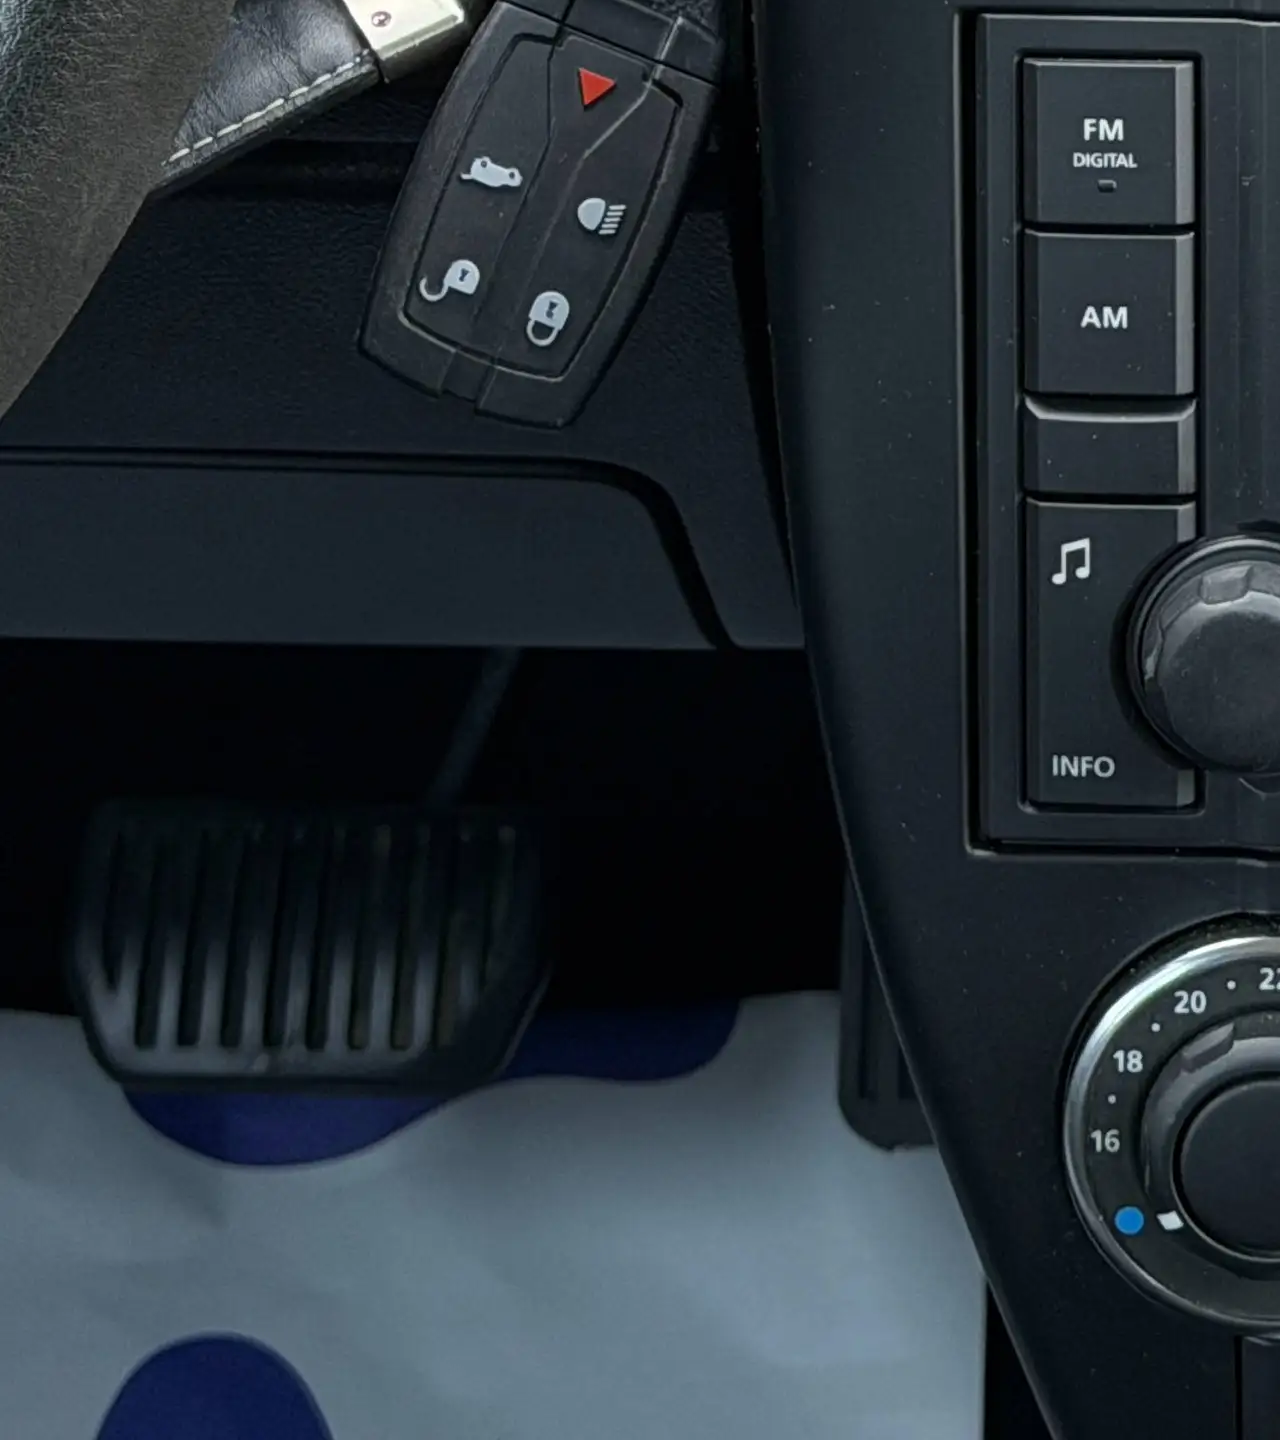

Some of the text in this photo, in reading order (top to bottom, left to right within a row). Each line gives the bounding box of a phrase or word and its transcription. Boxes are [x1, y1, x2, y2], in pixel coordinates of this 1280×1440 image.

[1083, 118, 1125, 141] FM
[1072, 152, 1138, 169] DIGITAL
[1080, 306, 1128, 329] AM
[1052, 755, 1115, 777] INFO
[1173, 990, 1207, 1014] 20
[1113, 1050, 1143, 1072] 18
[1090, 1130, 1121, 1153] 16
